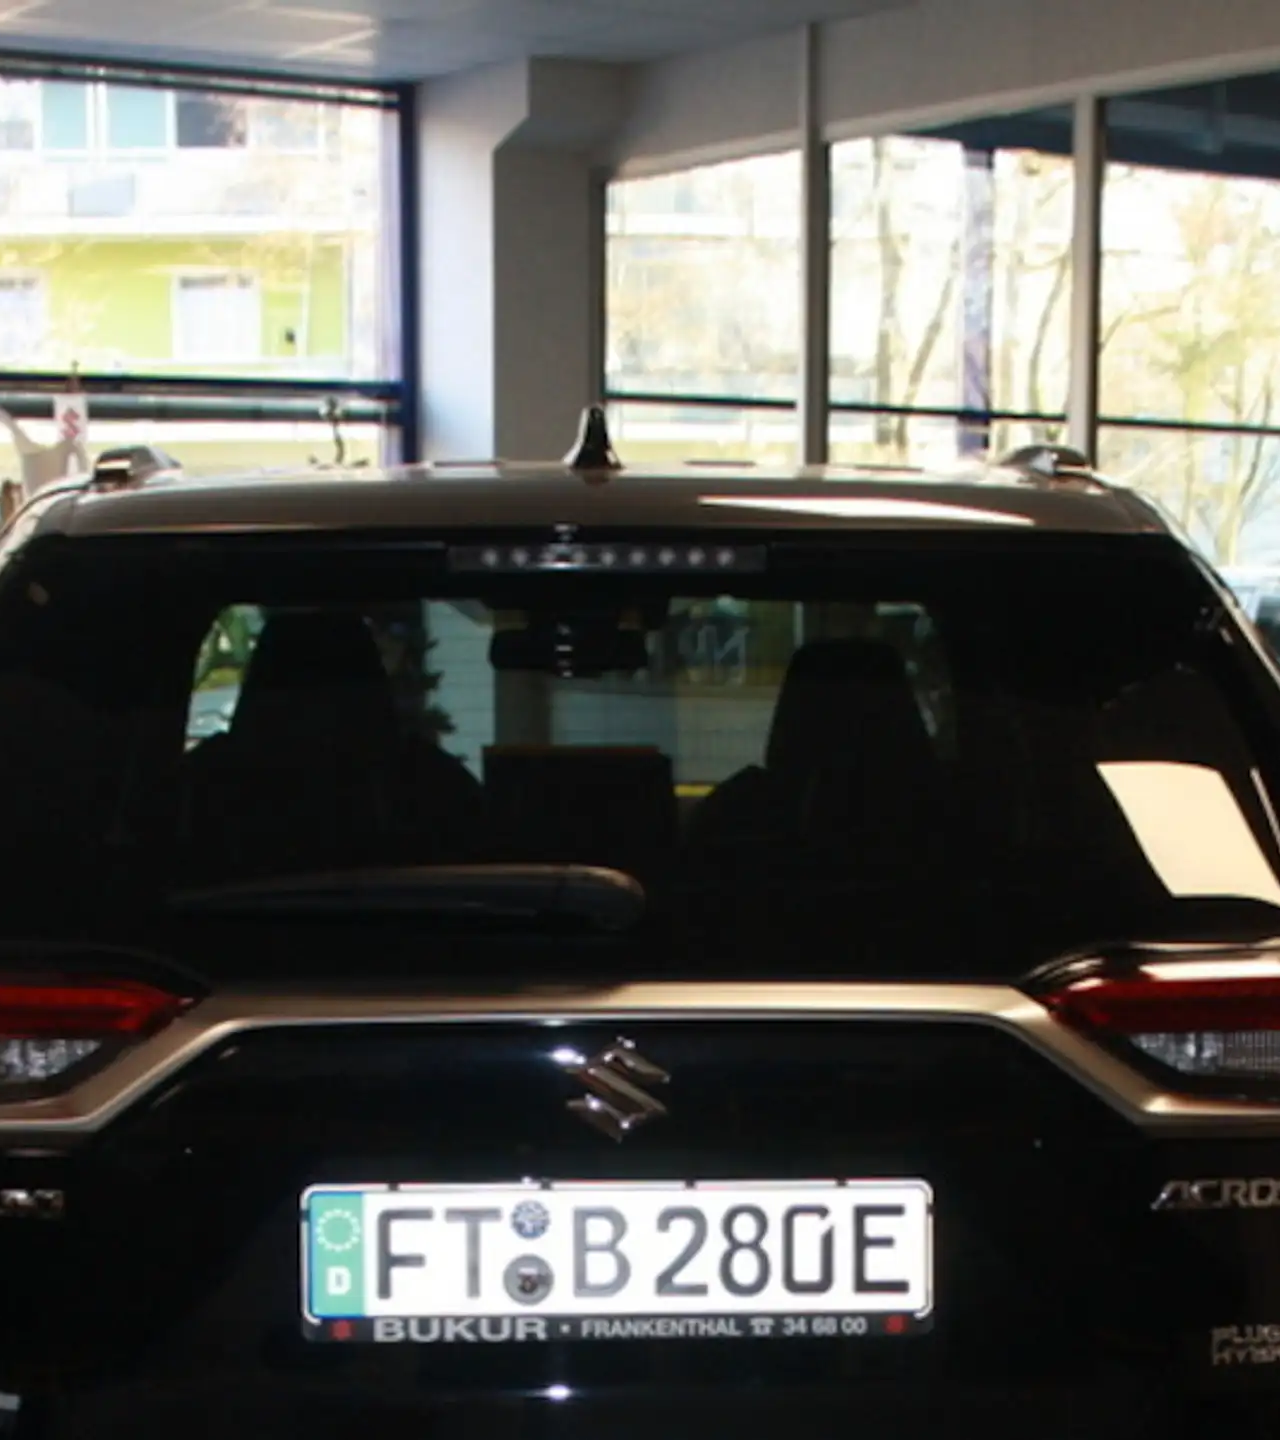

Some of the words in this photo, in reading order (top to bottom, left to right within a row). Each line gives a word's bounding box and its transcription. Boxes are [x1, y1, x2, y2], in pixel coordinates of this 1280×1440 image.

[377, 1206, 502, 1300] FT
[573, 1206, 631, 1298] B
[655, 1204, 910, 1297] 280E
[326, 1266, 351, 1295] D
[373, 1318, 548, 1343] BUKUR
[581, 1316, 741, 1338] FRANKENTHAL
[841, 1316, 868, 1336] 00
